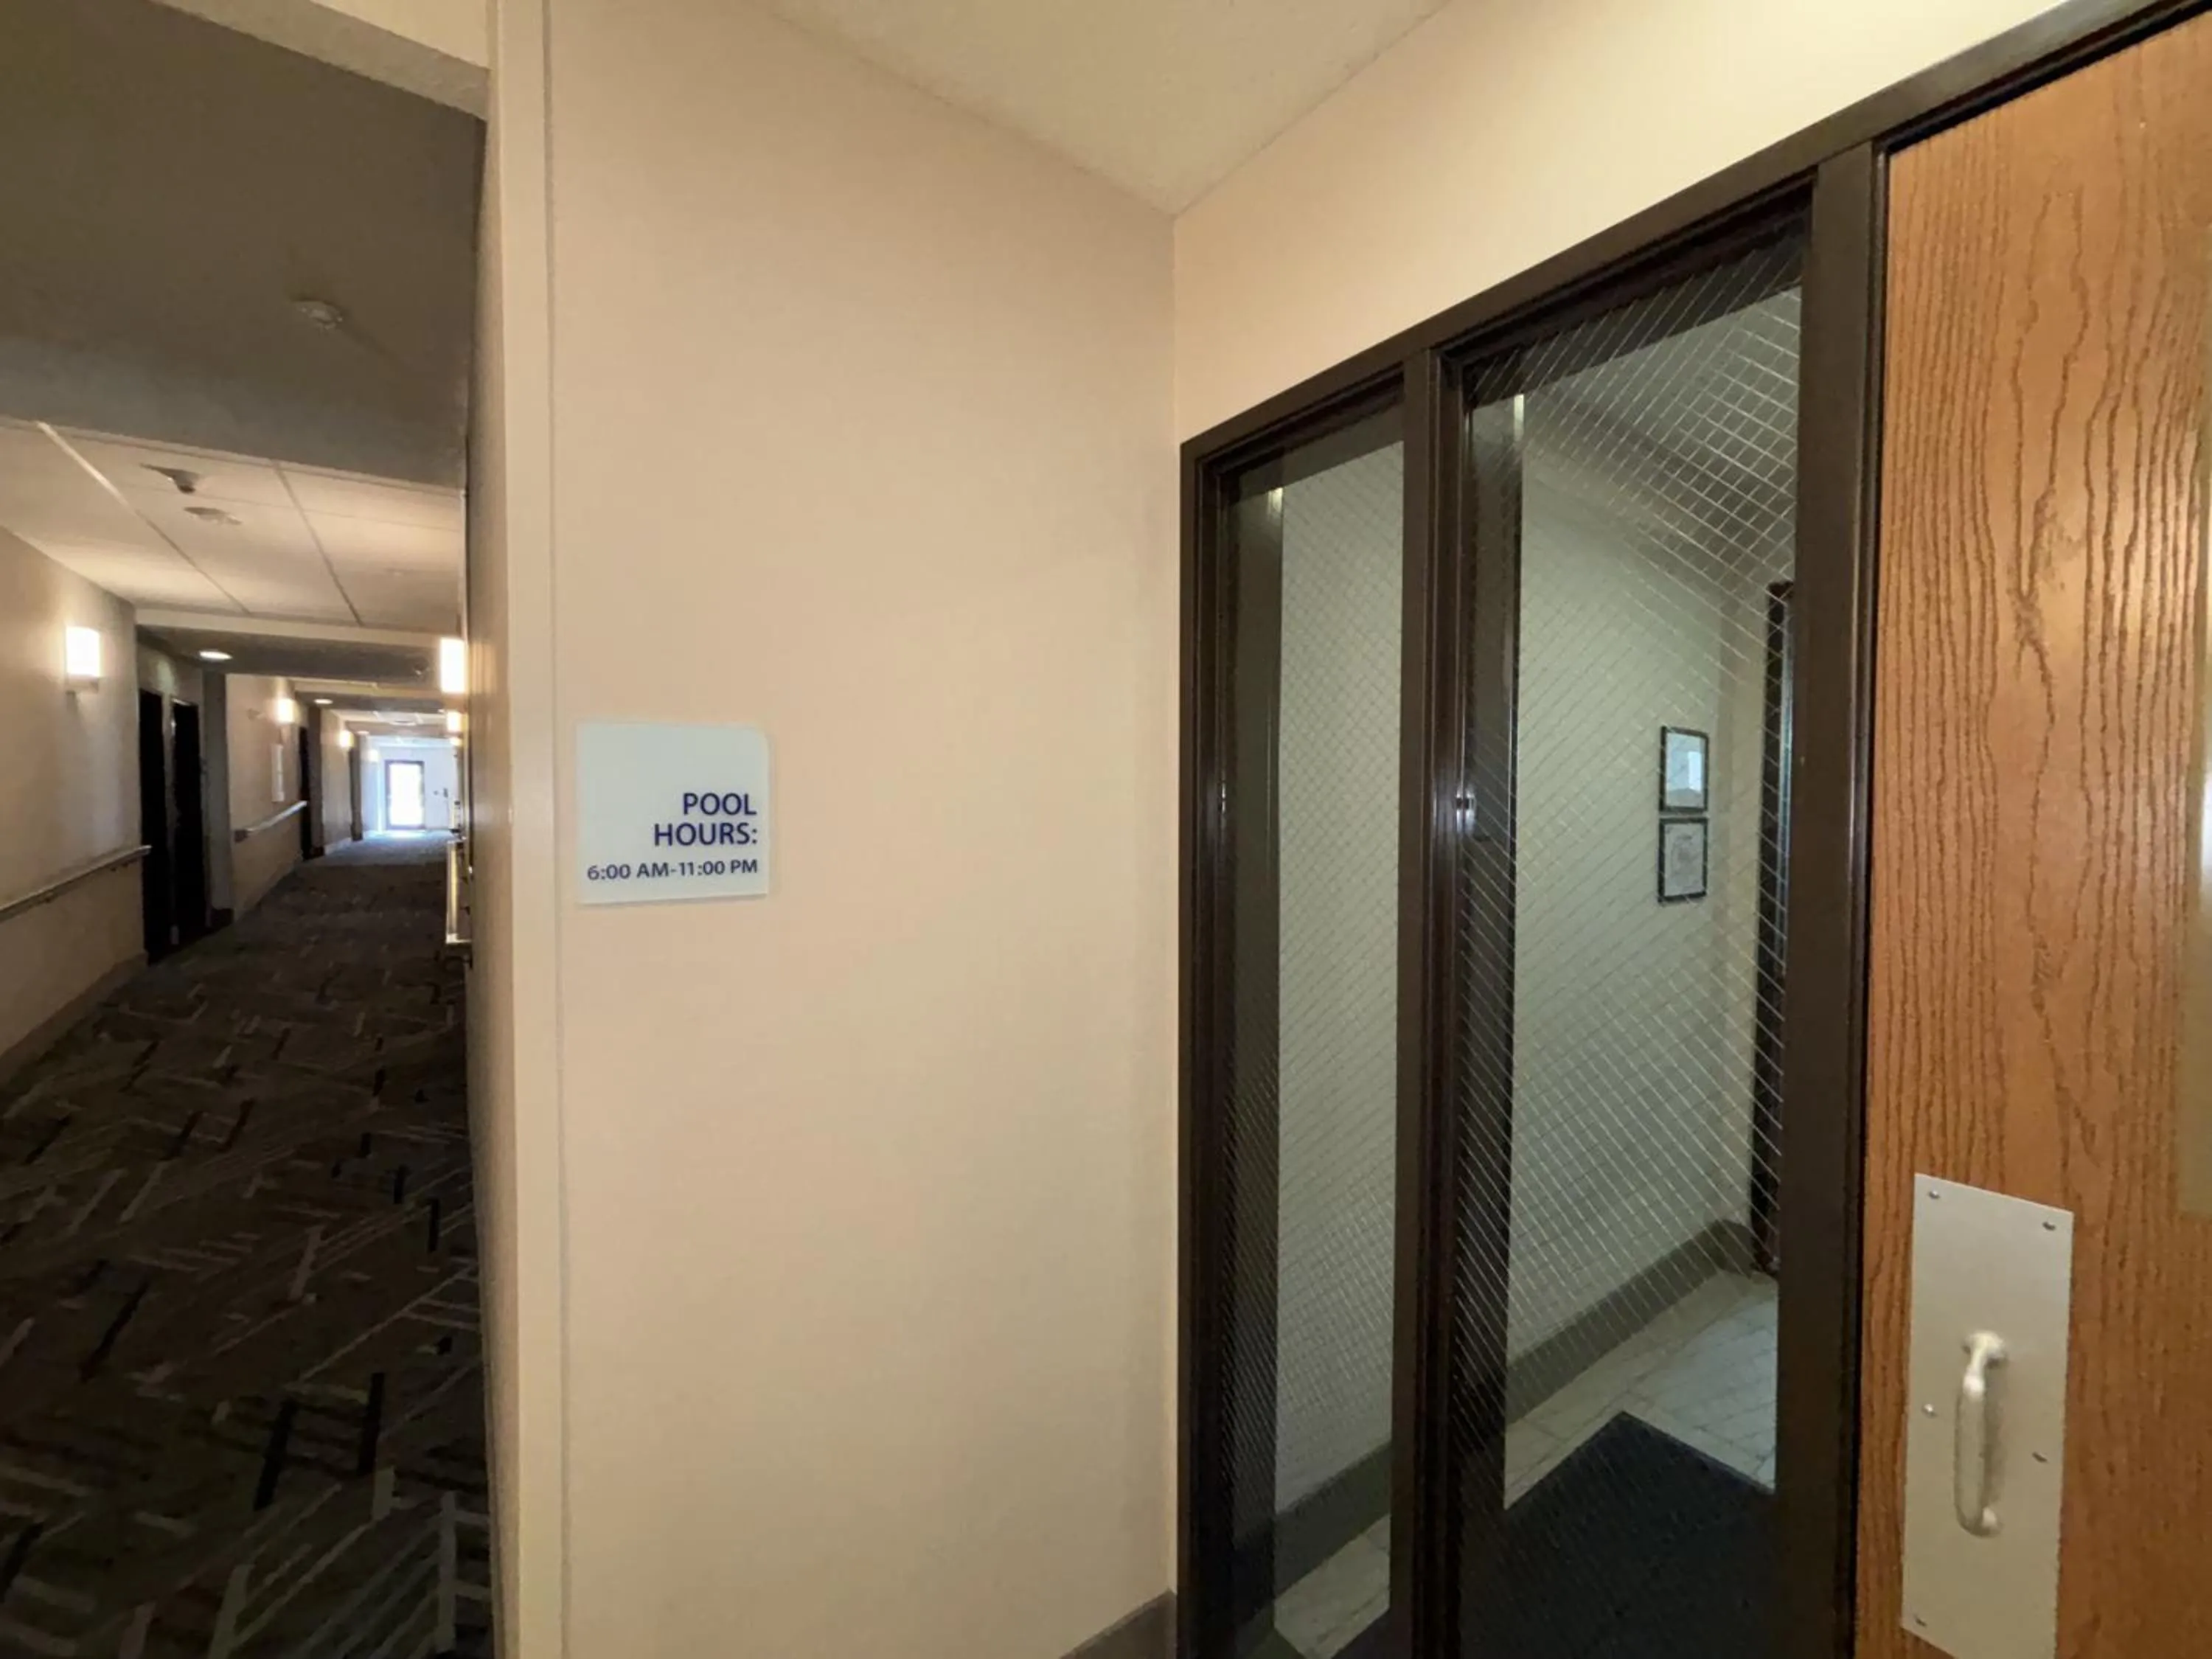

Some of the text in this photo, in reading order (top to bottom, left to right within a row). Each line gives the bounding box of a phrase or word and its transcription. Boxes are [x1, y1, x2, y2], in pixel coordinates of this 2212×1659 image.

[683, 793, 757, 815] POOL
[654, 822, 758, 846] HOURS:
[587, 864, 631, 880] 6:00
[730, 859, 758, 874] PM
